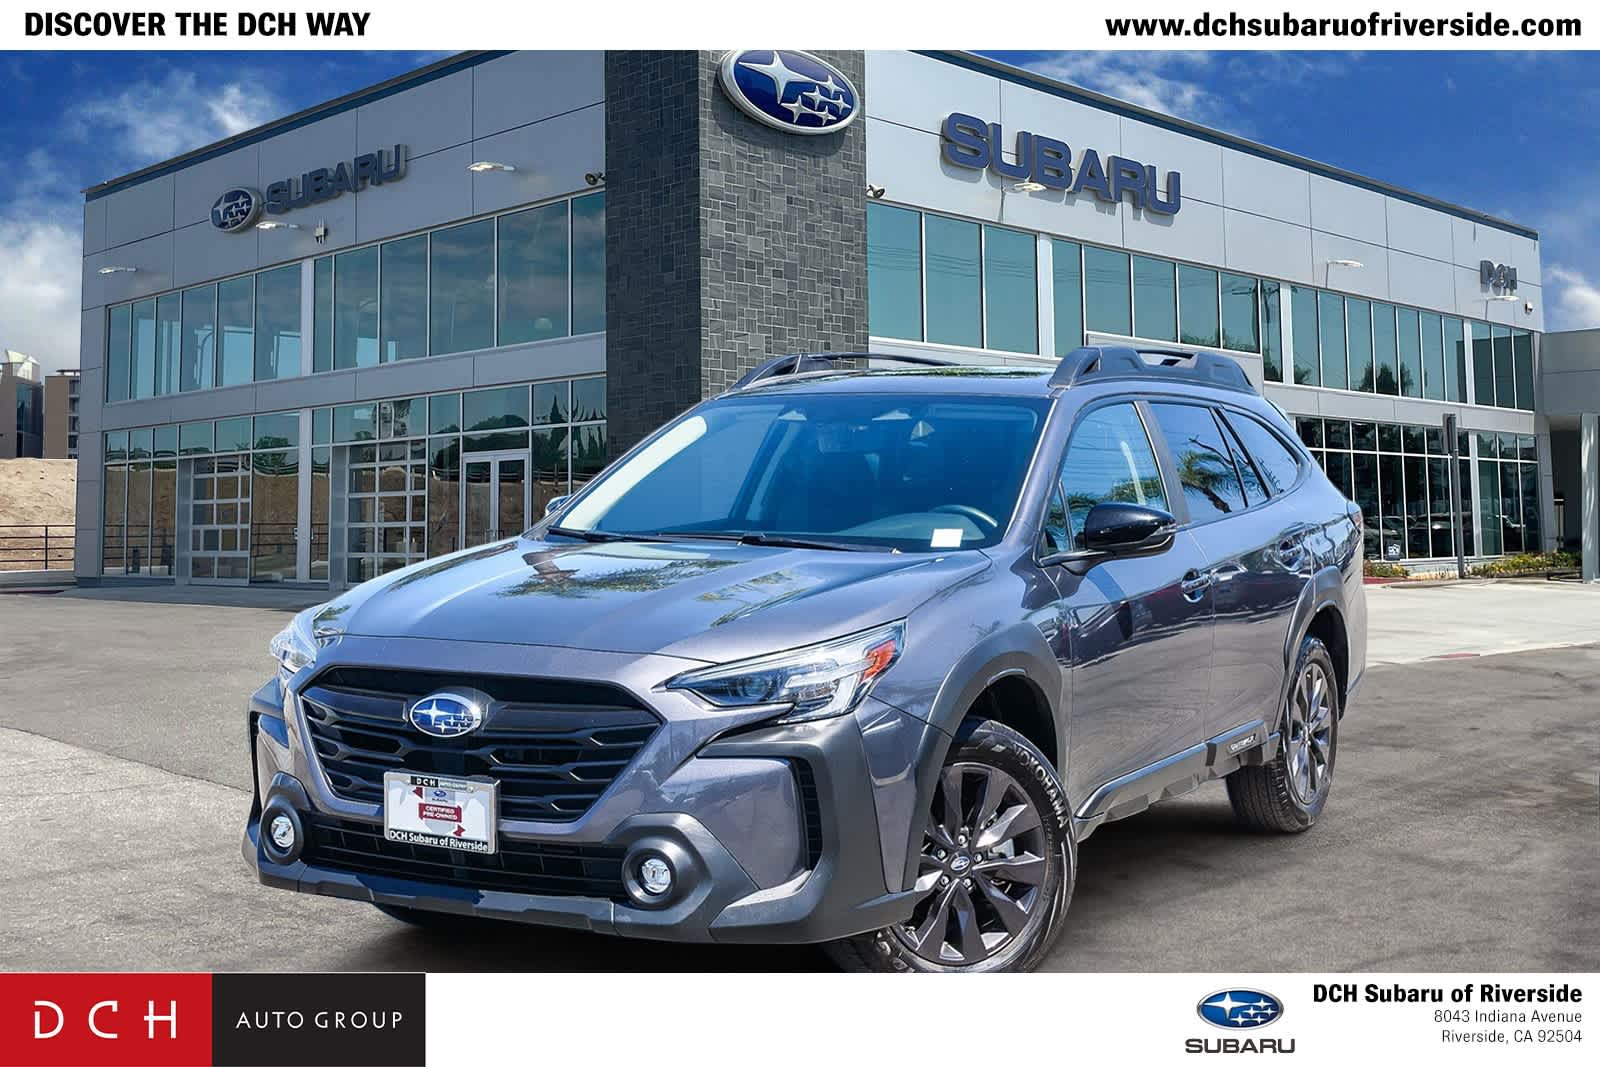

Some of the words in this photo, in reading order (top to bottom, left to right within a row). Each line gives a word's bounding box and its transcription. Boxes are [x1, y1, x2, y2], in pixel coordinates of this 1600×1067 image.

[266, 143, 407, 215] SUBARU
[941, 112, 1181, 215] SUBARU
[416, 778, 436, 787] DCH
[1013, 743, 1069, 829] YOKOHAMA
[389, 830, 408, 841] DCH
[409, 832, 438, 844] Subaru
[440, 836, 449, 846] of
[449, 839, 489, 852] Riverside
